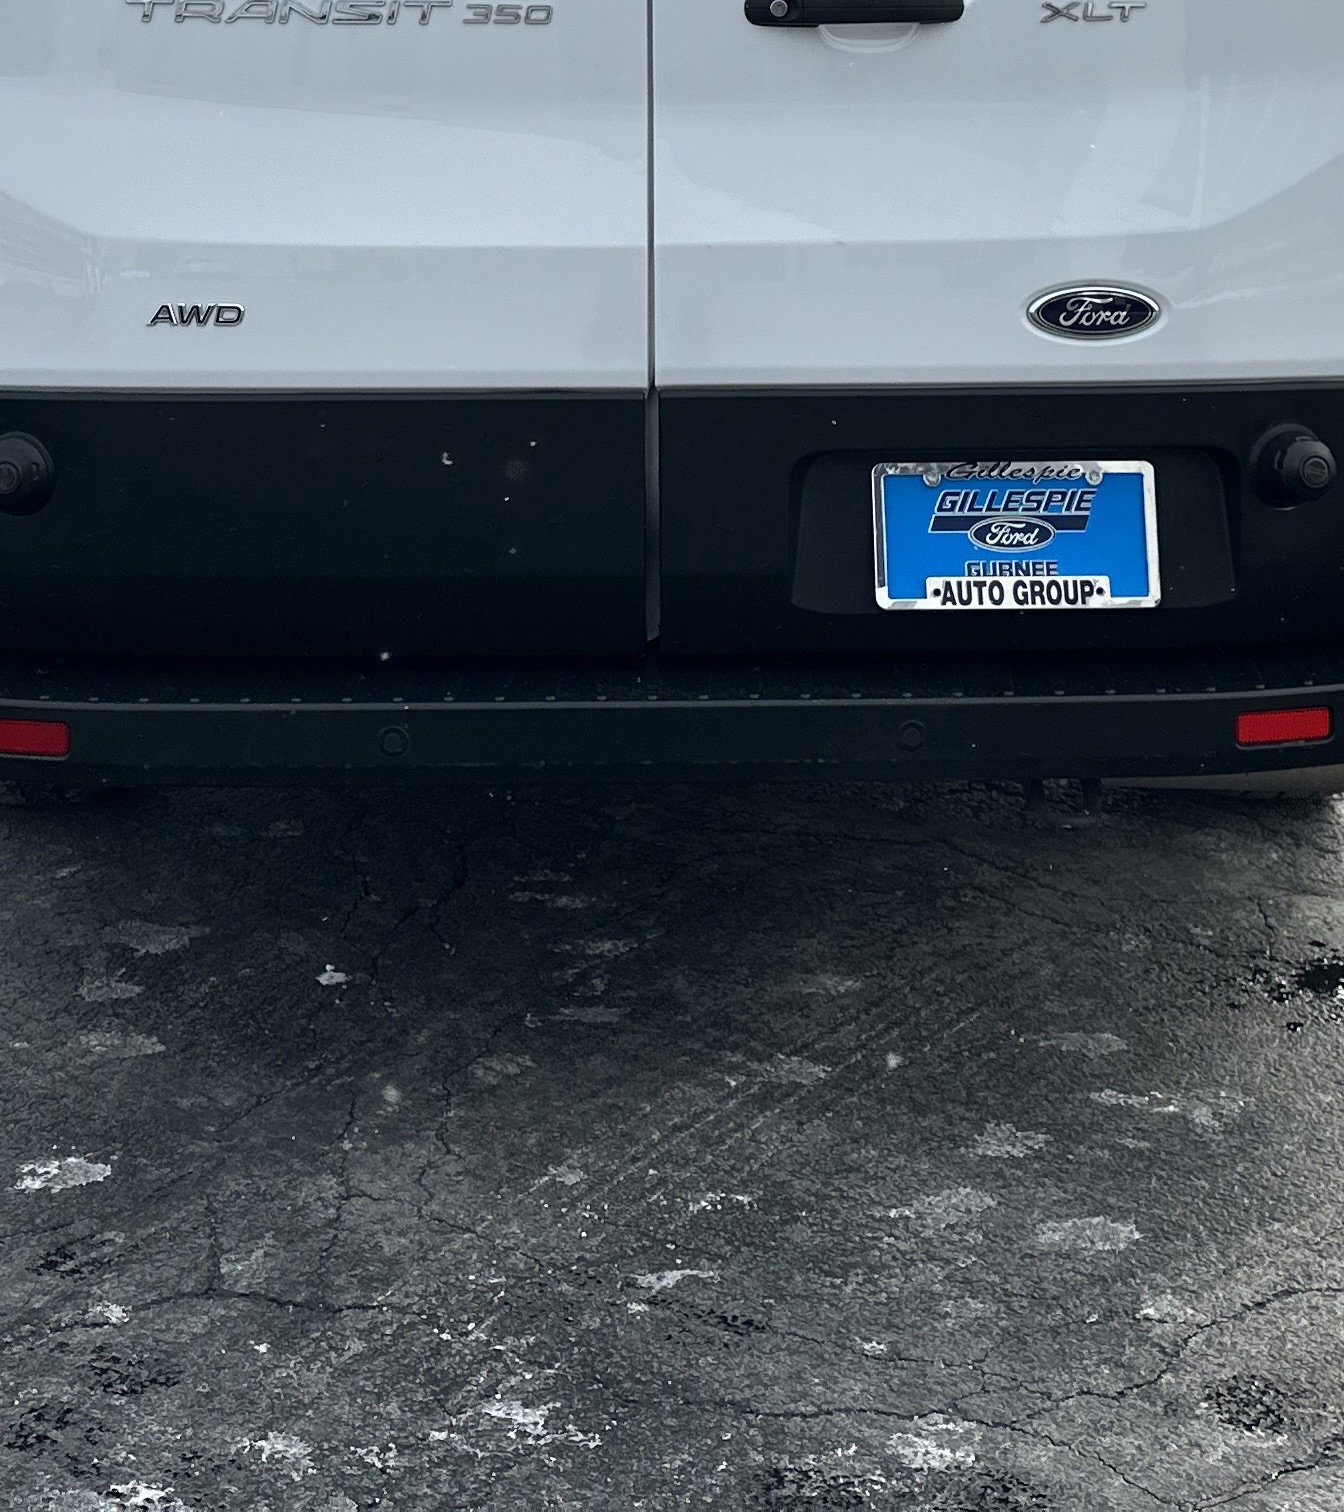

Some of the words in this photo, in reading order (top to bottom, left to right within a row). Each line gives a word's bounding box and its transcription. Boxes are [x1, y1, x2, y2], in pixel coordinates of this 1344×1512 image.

[462, 4, 553, 25] 350
[1040, 1, 1147, 23] XLT
[146, 303, 245, 327] AWD
[1059, 296, 1130, 326] Ford
[945, 460, 1083, 484] Gillespie
[935, 489, 1097, 513] GILLESPIE
[985, 521, 1039, 545] Ford
[965, 559, 1058, 576] GURNEE
[941, 580, 1004, 606] AUTO
[1013, 579, 1095, 606] GROUP
